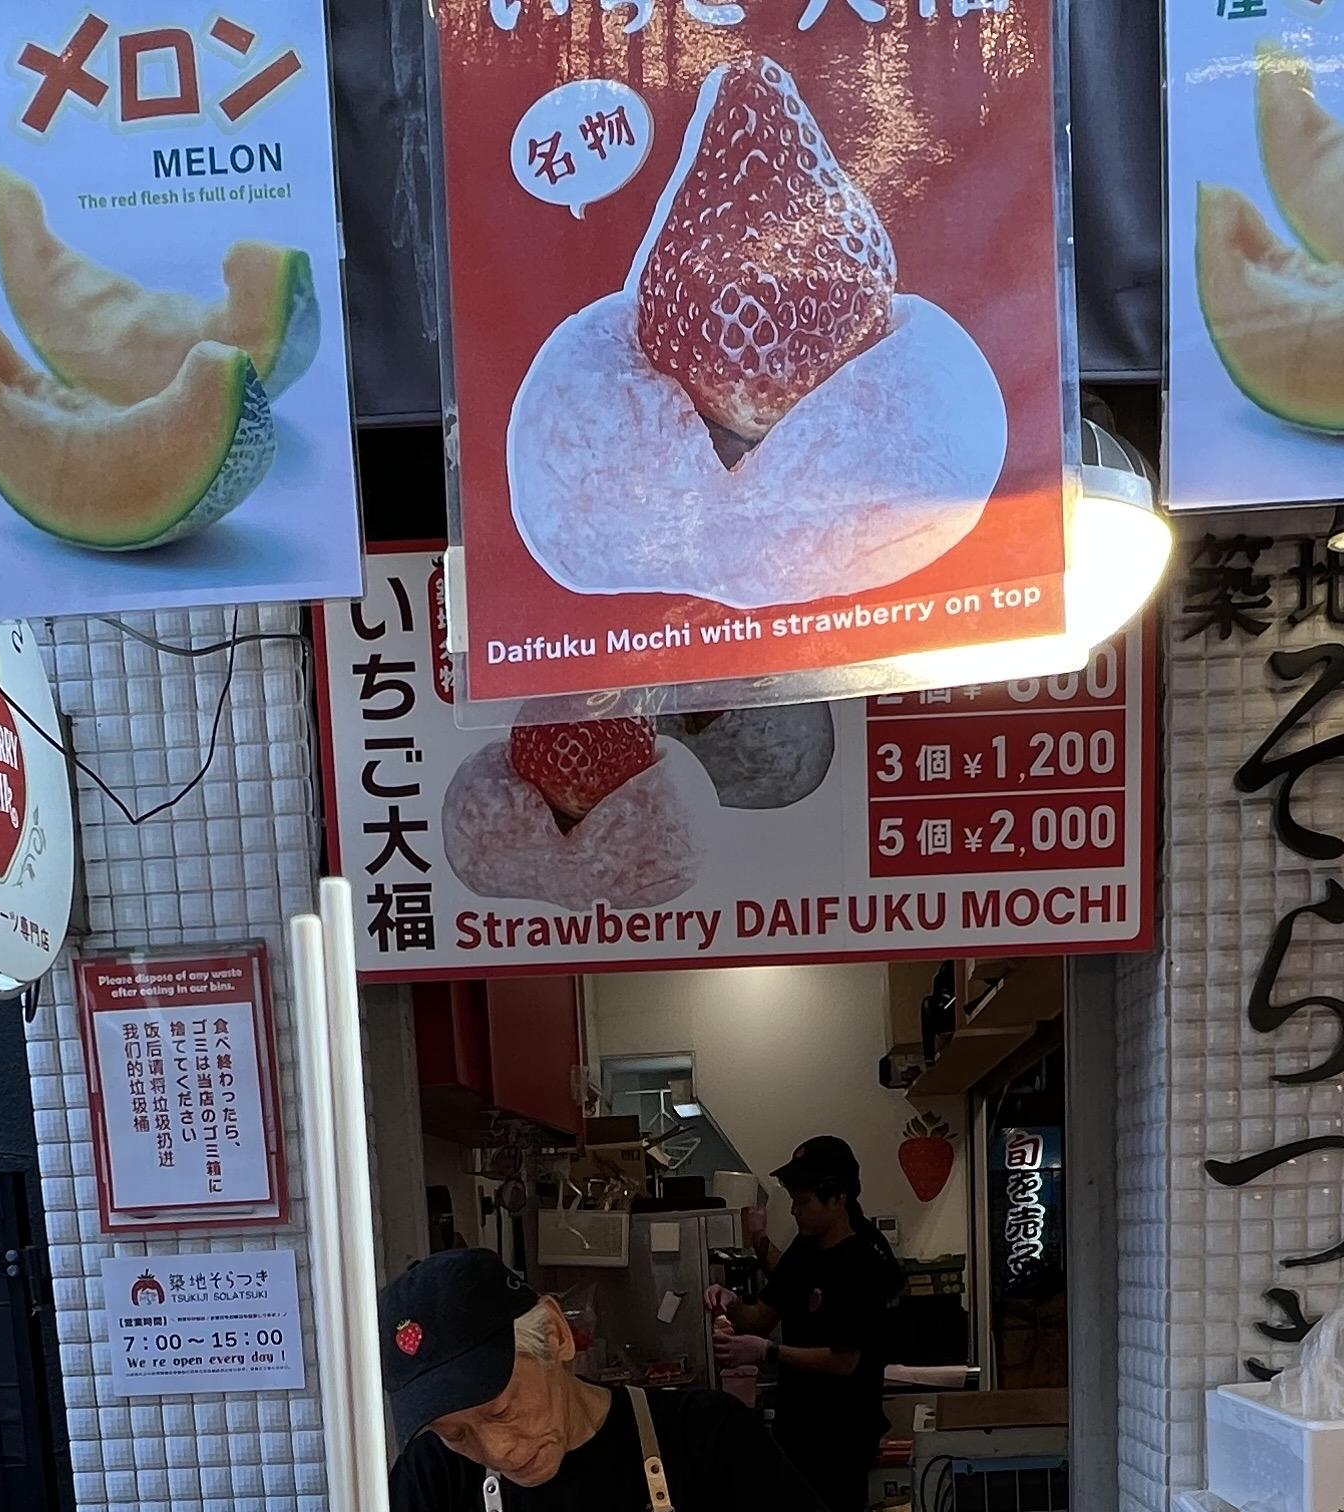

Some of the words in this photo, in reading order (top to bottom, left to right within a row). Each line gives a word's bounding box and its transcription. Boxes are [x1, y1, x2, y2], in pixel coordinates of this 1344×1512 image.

[16, 13, 303, 134] メロン
[153, 143, 284, 179] MELON
[527, 105, 637, 186] 名物
[78, 193, 108, 210] The
[112, 192, 137, 209] red
[140, 188, 179, 207] flesh
[181, 188, 196, 205] is
[199, 186, 227, 203] full
[229, 185, 245, 202] of
[247, 182, 292, 204] juice!
[486, 631, 598, 665] Daifuku
[606, 622, 692, 654] Mochi
[700, 615, 763, 645] with
[771, 597, 936, 638] strawberry
[944, 590, 981, 616] on
[989, 582, 1042, 616] top
[349, 576, 437, 953] いちご大福
[456, 903, 720, 950] Strawberry
[735, 893, 947, 941] DAIFUKU
[961, 886, 1128, 930] MOCHI
[98, 975, 133, 987] Please
[135, 972, 173, 985] dispose
[175, 970, 187, 981] of
[189, 971, 209, 982] any
[211, 968, 242, 978] waste
[111, 986, 137, 998] after
[177, 984, 188, 994] in
[190, 984, 208, 994] our
[173, 1356, 203, 1368] open
[209, 1353, 244, 1366] every
[251, 1351, 274, 1364] day
